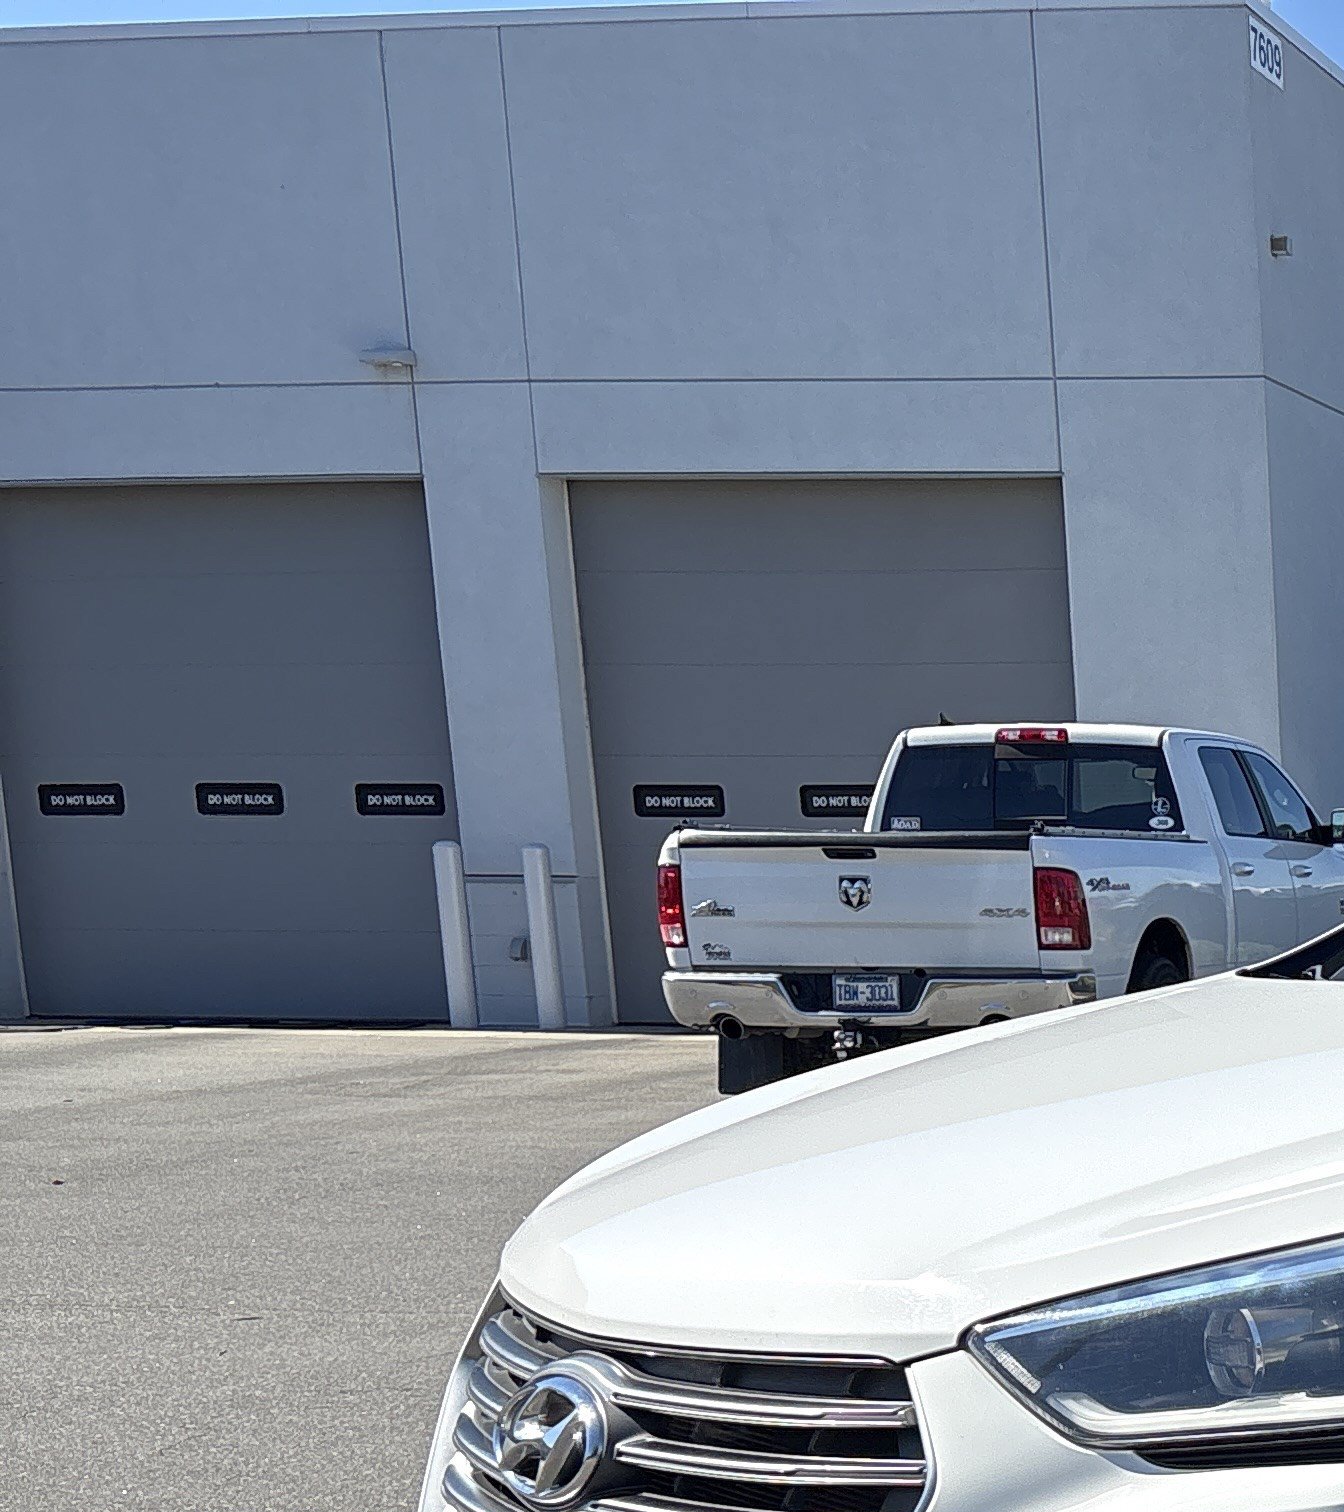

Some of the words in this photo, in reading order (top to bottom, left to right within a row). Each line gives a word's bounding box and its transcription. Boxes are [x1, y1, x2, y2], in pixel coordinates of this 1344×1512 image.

[1250, 25, 1282, 80] 7609
[51, 795, 64, 806] DO
[65, 795, 85, 806] NOT
[86, 794, 116, 806] BLOCK
[207, 794, 222, 805] DO
[223, 794, 242, 805] NOT
[244, 793, 275, 805] BLOCK
[367, 794, 382, 806] DO
[383, 794, 403, 806] NOT
[404, 794, 436, 806] BLOCK
[645, 796, 660, 807] DO
[661, 796, 682, 807] NOT
[683, 796, 715, 808] BLOCK
[812, 796, 827, 807] DO
[828, 796, 849, 807] NOT
[850, 796, 872, 807] BLO
